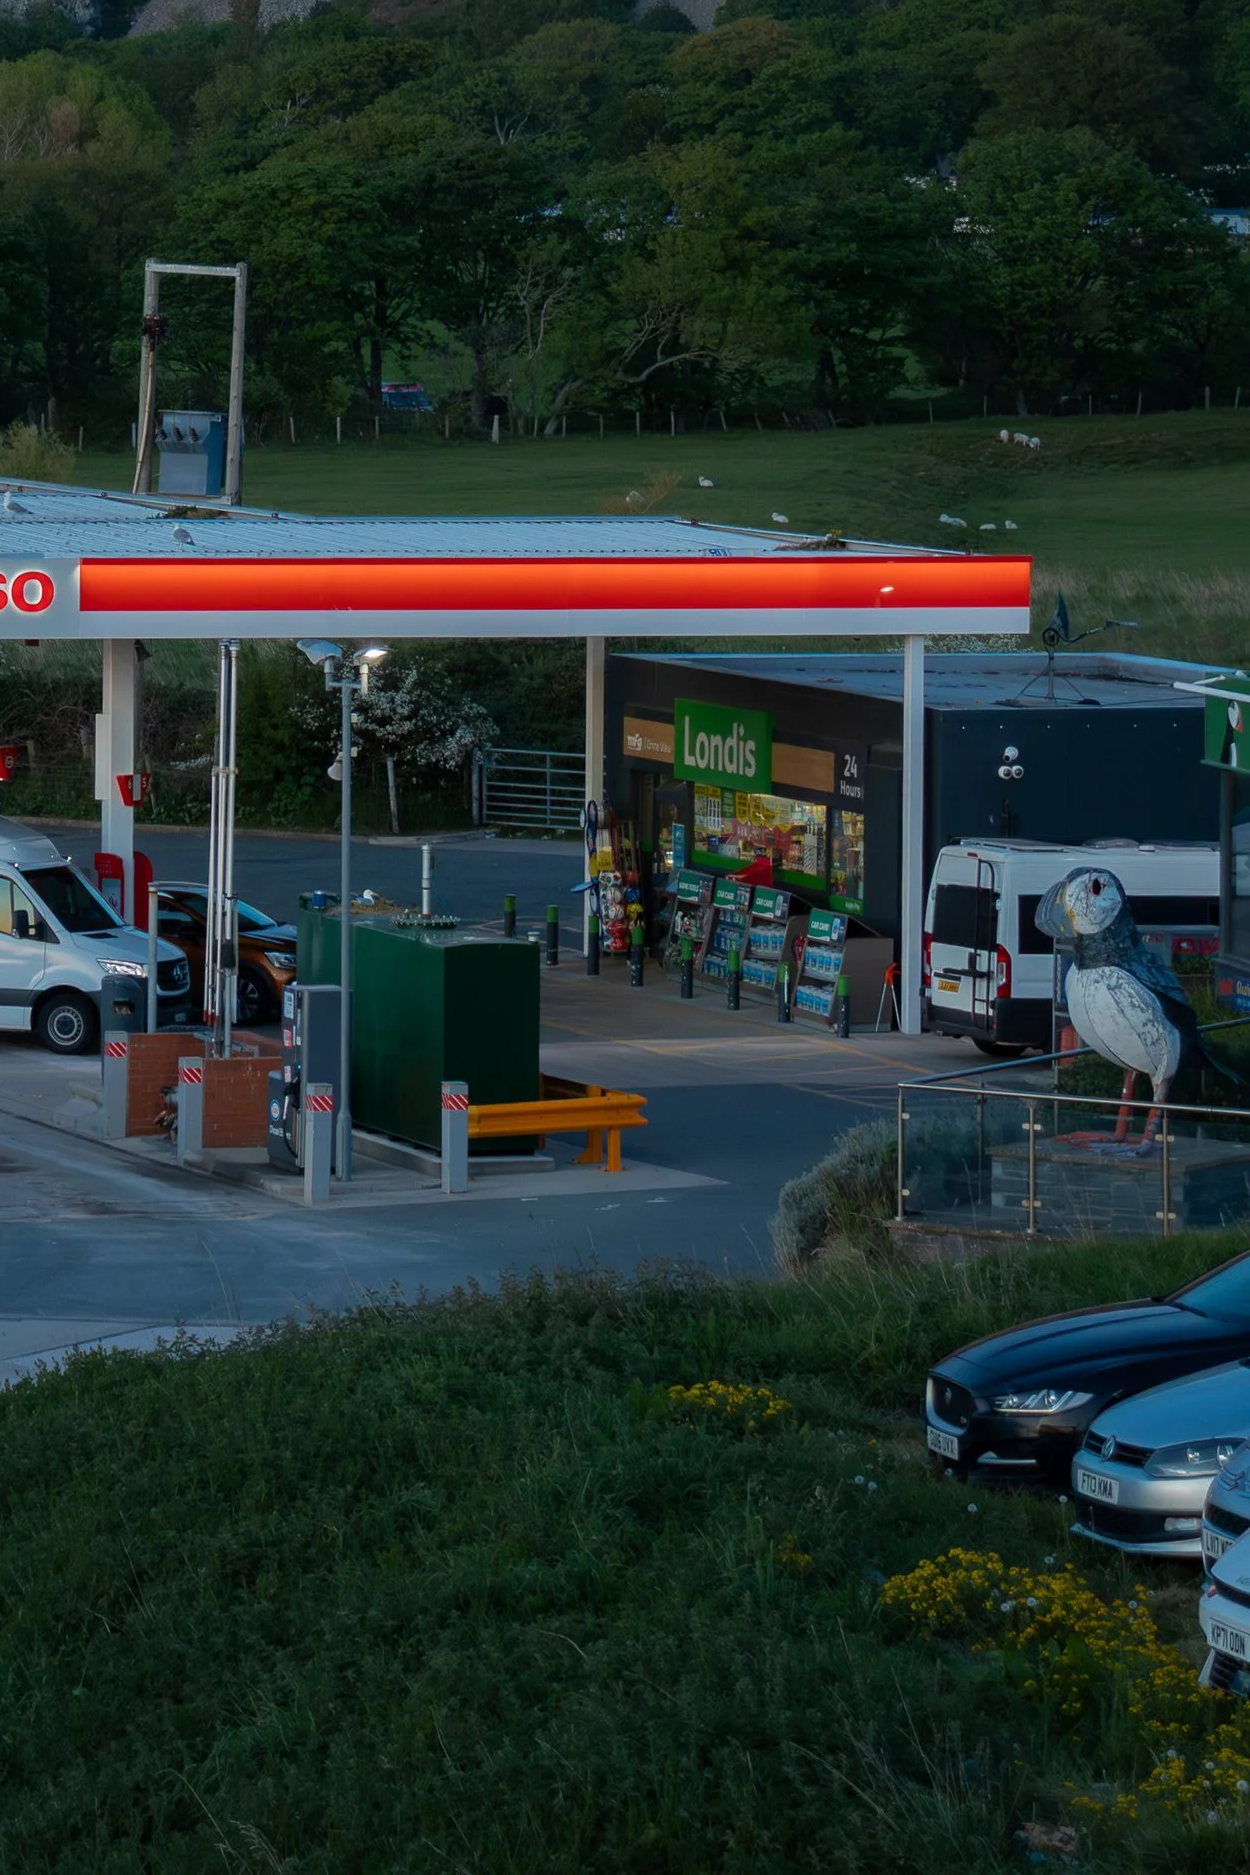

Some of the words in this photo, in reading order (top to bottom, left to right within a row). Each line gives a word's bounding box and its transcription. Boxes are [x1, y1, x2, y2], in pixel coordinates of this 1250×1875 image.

[684, 715, 756, 778] Londis
[843, 754, 858, 779] 24
[840, 779, 861, 798] Hours
[1211, 1623, 1228, 1648] KP71
